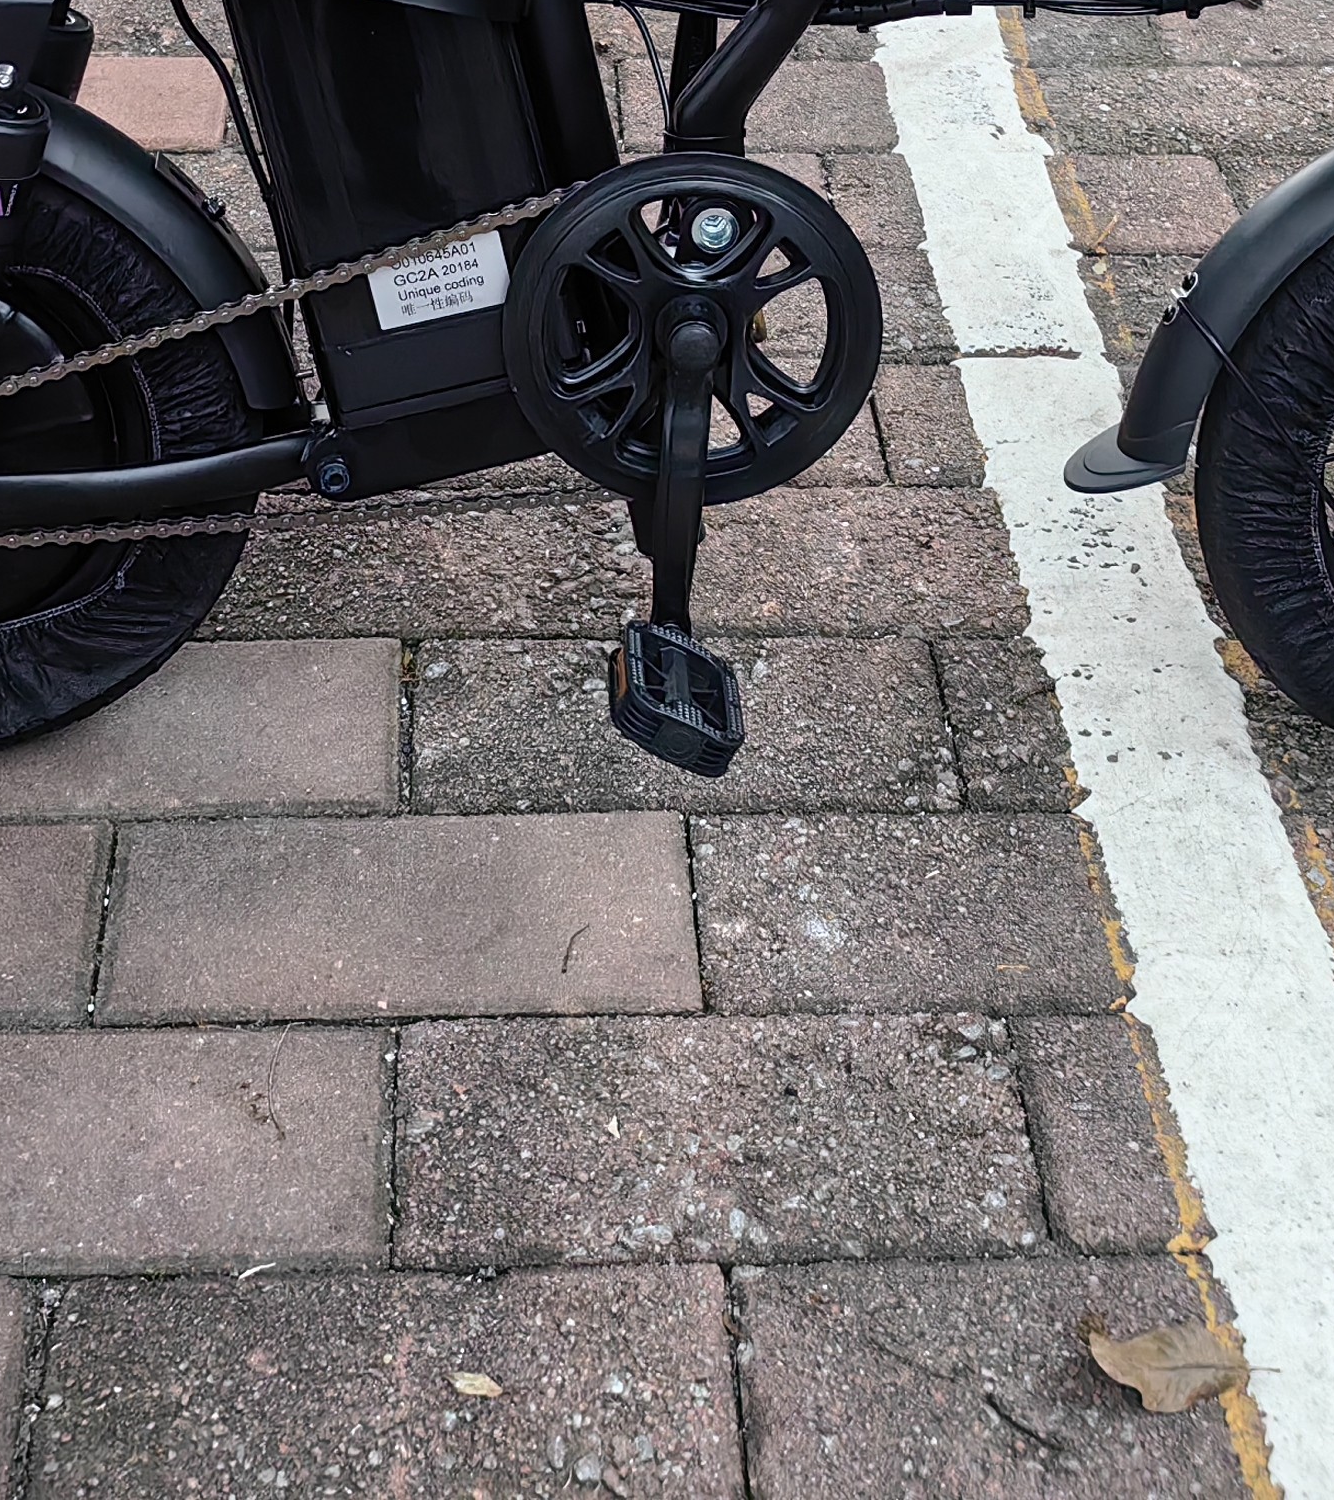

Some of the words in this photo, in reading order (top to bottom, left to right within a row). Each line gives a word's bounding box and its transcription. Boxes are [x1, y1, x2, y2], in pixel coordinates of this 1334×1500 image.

[393, 267, 439, 286] GC2A
[441, 258, 479, 276] 20184
[398, 285, 441, 301] Unique
[444, 275, 485, 291] coding
[401, 290, 473, 316] 唯一性编码
